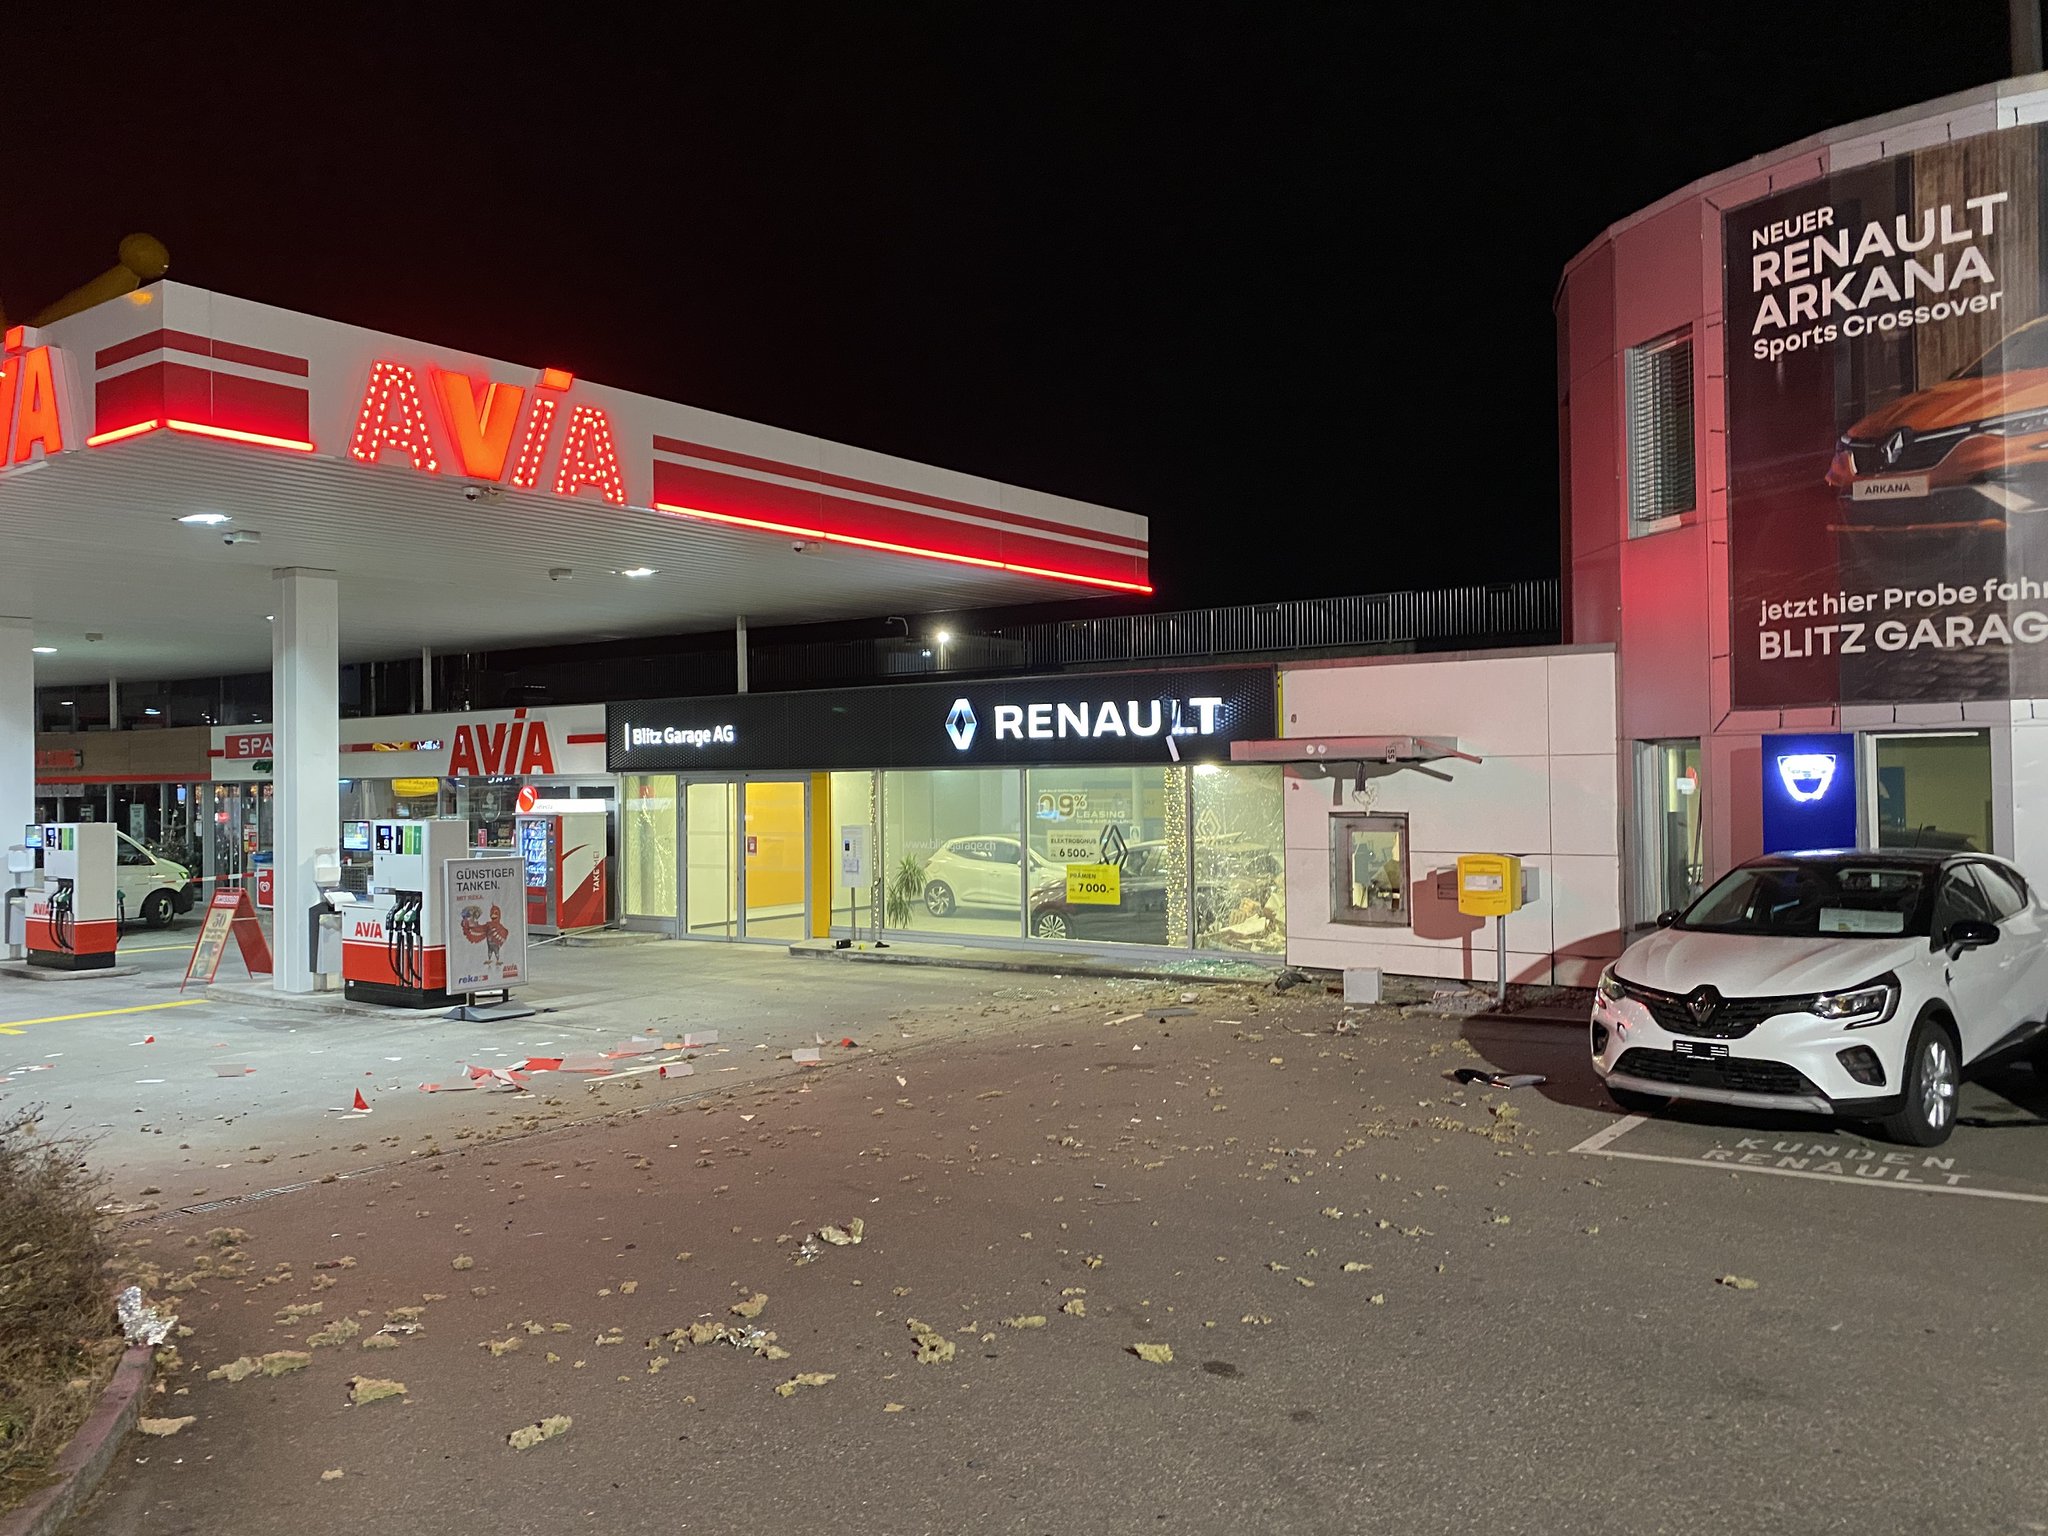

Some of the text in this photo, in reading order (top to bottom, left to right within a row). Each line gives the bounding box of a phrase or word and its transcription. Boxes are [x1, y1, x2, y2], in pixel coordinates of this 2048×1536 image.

[1752, 206, 1834, 250] NEUER
[1752, 191, 2008, 293] RENAULT
[1752, 245, 1996, 336] ARKANA
[1753, 291, 2003, 362] Sports Crossover
[1864, 482, 1911, 495] ARKANA
[1759, 600, 1818, 627] jetzt
[1823, 591, 1878, 615] hier
[1884, 583, 1977, 610] Probe
[1759, 623, 1866, 660] BLITZ
[632, 725, 735, 747] Blitz Garage AG
[994, 697, 1222, 740] RENAULT
[1076, 810, 1126, 819] LEASING
[456, 868, 515, 880] GÜNSTIGER
[457, 880, 501, 892] TANKEN.
[592, 868, 600, 892] TAKE
[1702, 1149, 1971, 1186] RENAULT
[1735, 1137, 1955, 1170] KUNDEN
